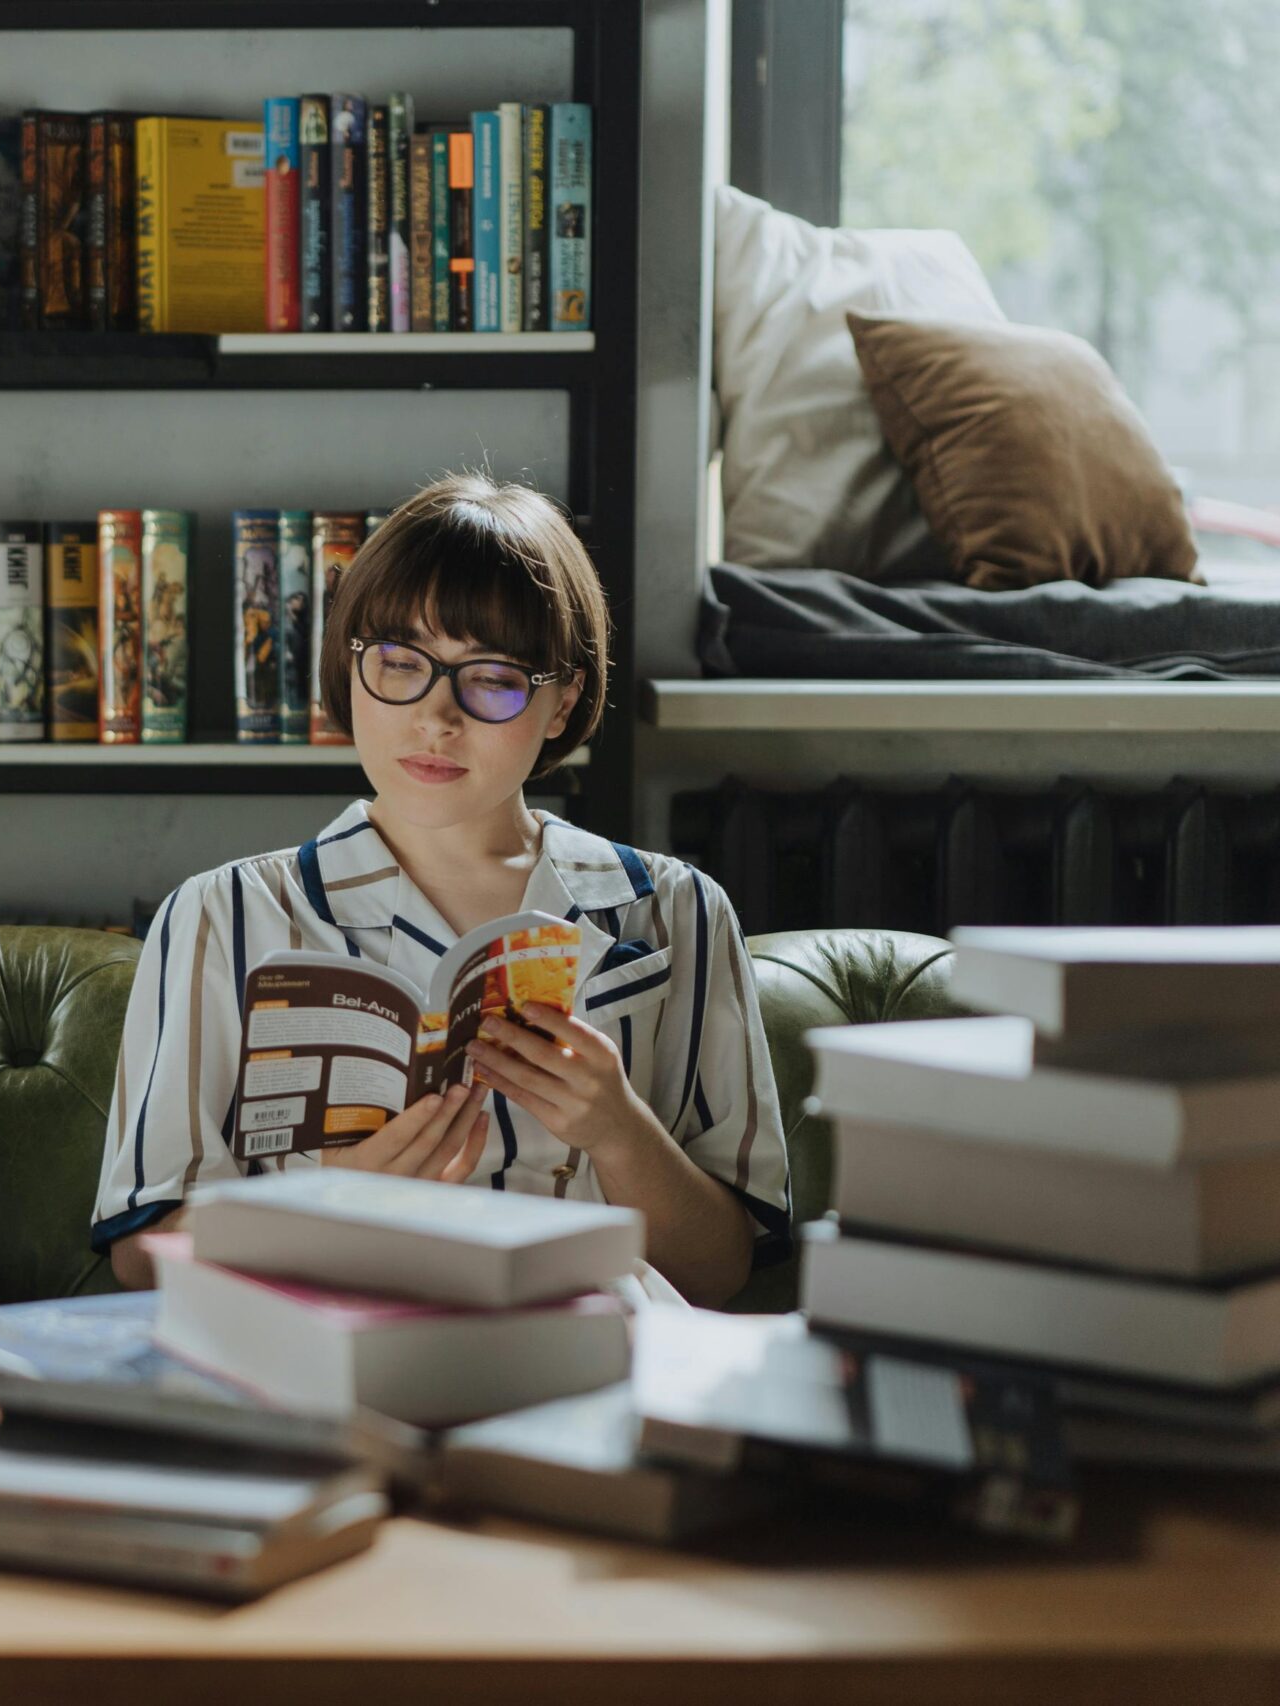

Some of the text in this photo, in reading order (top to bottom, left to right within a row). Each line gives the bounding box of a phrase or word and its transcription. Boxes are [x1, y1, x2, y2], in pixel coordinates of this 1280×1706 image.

[7, 546, 29, 590] КИНГ
[63, 545, 83, 584] КИНГ
[331, 992, 400, 1023] Bel-Ami
